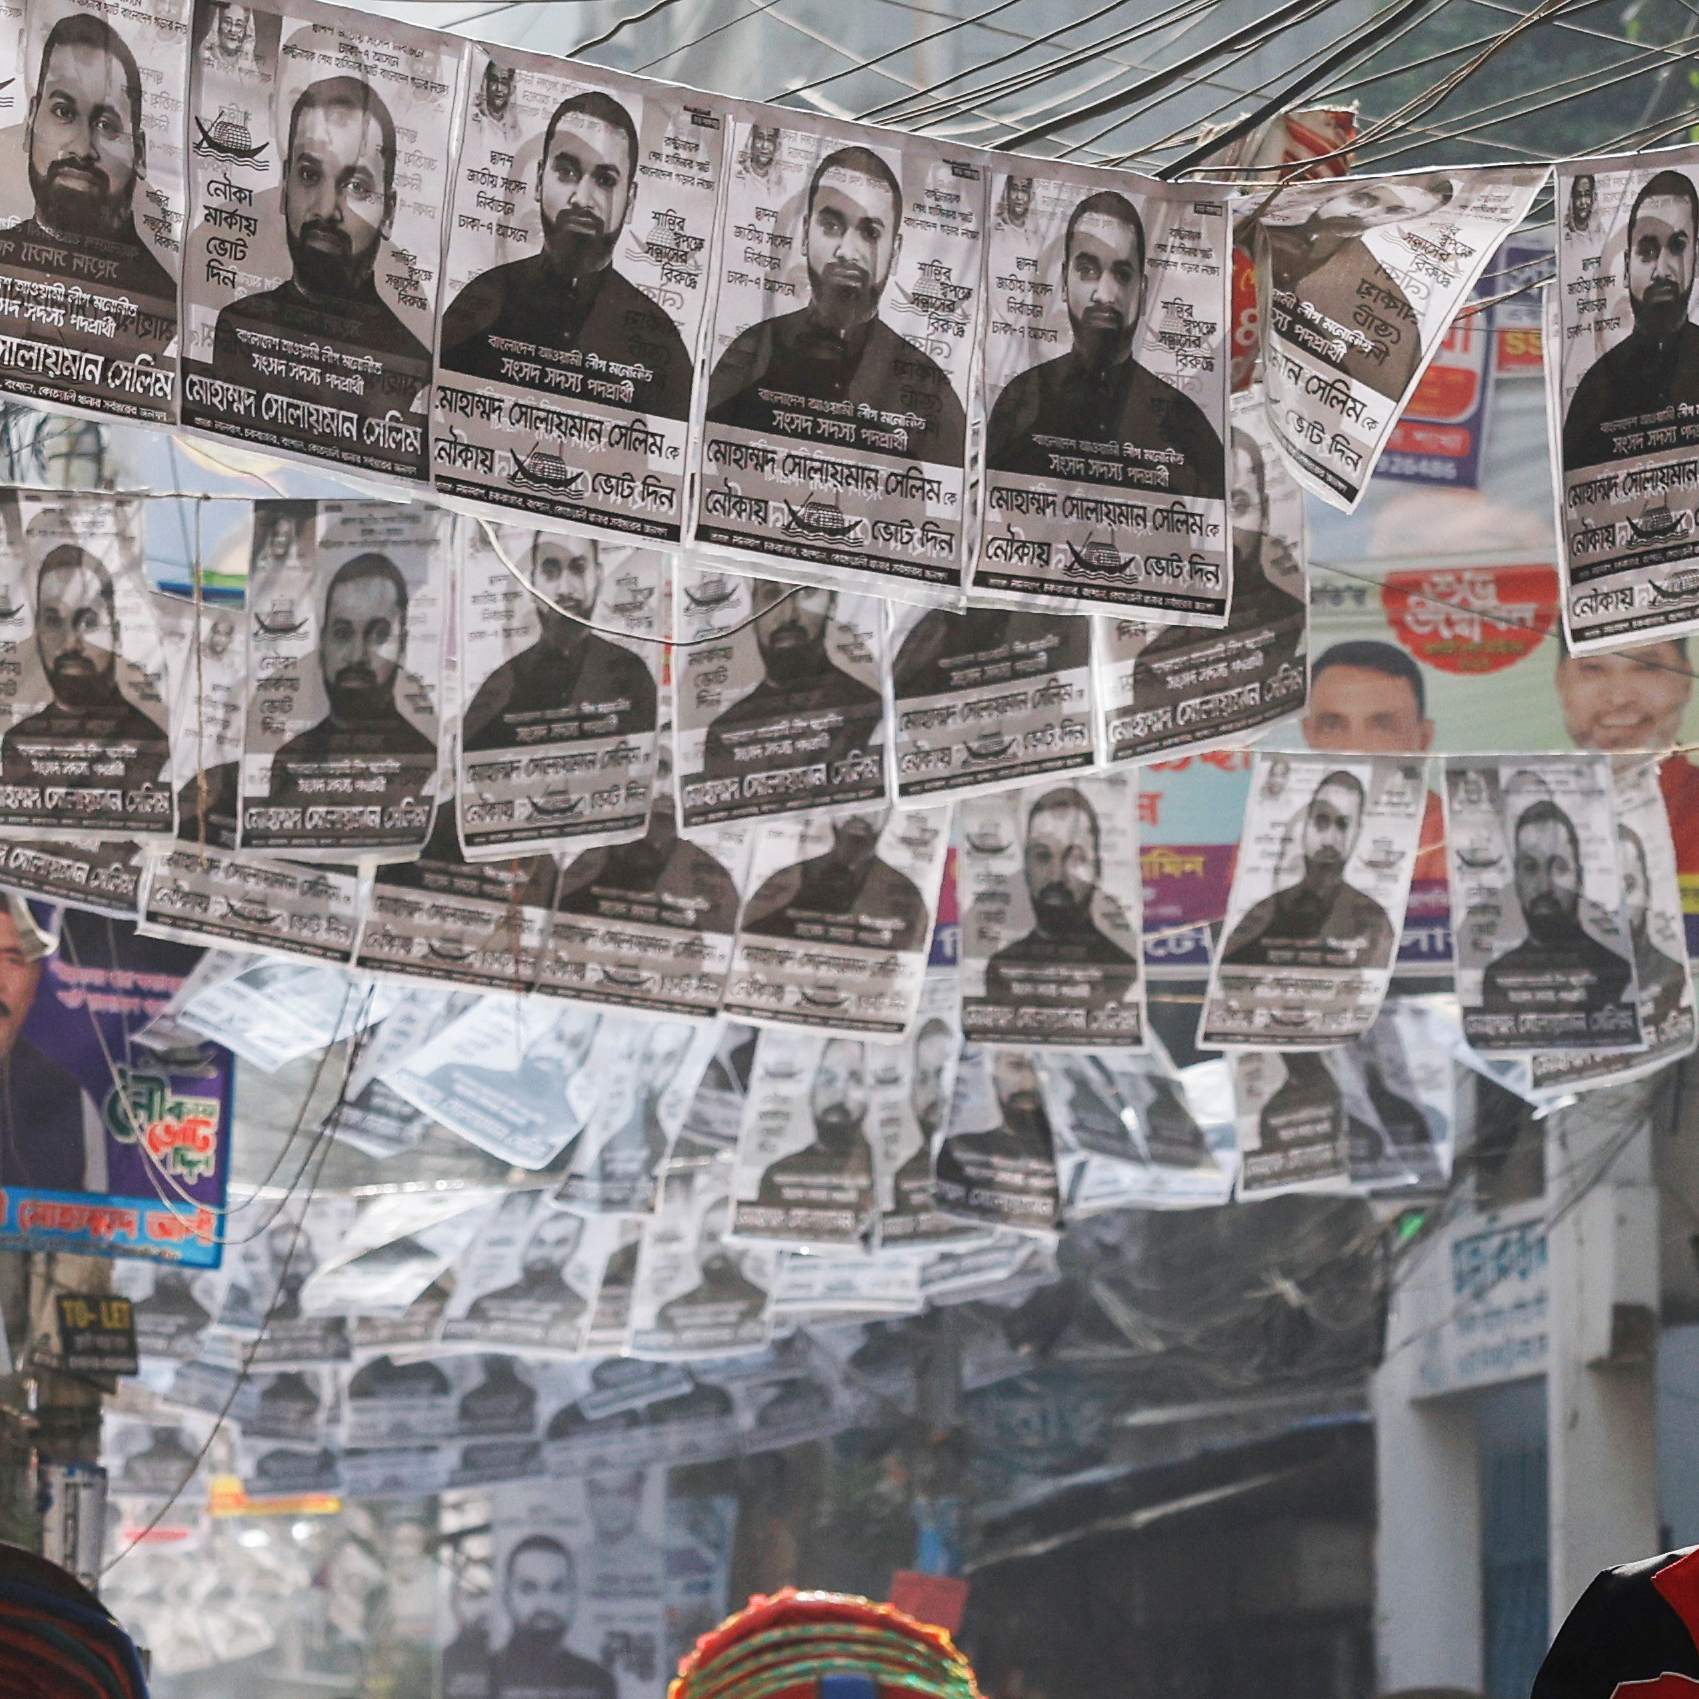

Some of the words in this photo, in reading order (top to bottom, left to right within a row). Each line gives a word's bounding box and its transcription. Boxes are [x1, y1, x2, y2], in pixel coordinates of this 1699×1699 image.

[206, 173, 254, 208] নৌকা
[204, 204, 258, 238] মার্কায়
[651, 209, 685, 232] শান্তির
[206, 236, 248, 262] ভোট
[206, 258, 238, 289] দিন
[661, 264, 699, 290] বিরুদ্ধে
[24, 300, 65, 328] সদস্য
[70, 314, 117, 339] পদপ্রার্থী
[107, 353, 176, 400] সেলিম
[186, 373, 257, 418] মোহাম্মদ
[262, 392, 358, 442] সোলায়মান
[362, 409, 423, 455] সেলিম
[1305, 374, 1367, 424] সেলিম
[1362, 415, 1379, 432] কে
[509, 401, 603, 444] সোলায়মান
[609, 418, 665, 459] সেলিম
[665, 444, 681, 460] কে
[1286, 409, 1325, 447] ভোট
[1329, 431, 1363, 472] দিন
[592, 472, 635, 499] ভোট
[641, 474, 675, 509] দিন
[706, 439, 777, 474] মোহাম্মদ
[782, 453, 880, 492] সোলায়মান
[885, 466, 942, 504] সেলিম
[1567, 474, 1619, 509] মোহাম্মদ
[1622, 460, 1698, 496] সোলায়মান
[705, 477, 768, 526] নৌকায়
[872, 518, 916, 544] ভোট
[921, 520, 955, 554] দিন
[990, 485, 1057, 518] মোহাম্মদ
[1062, 495, 1147, 530] সোলায়মান
[1152, 501, 1204, 537] সেলিম
[986, 523, 1052, 567] নৌকায়
[1144, 552, 1183, 578] ভোট
[1189, 553, 1220, 584] দিন
[1571, 517, 1616, 557] নৌকায়
